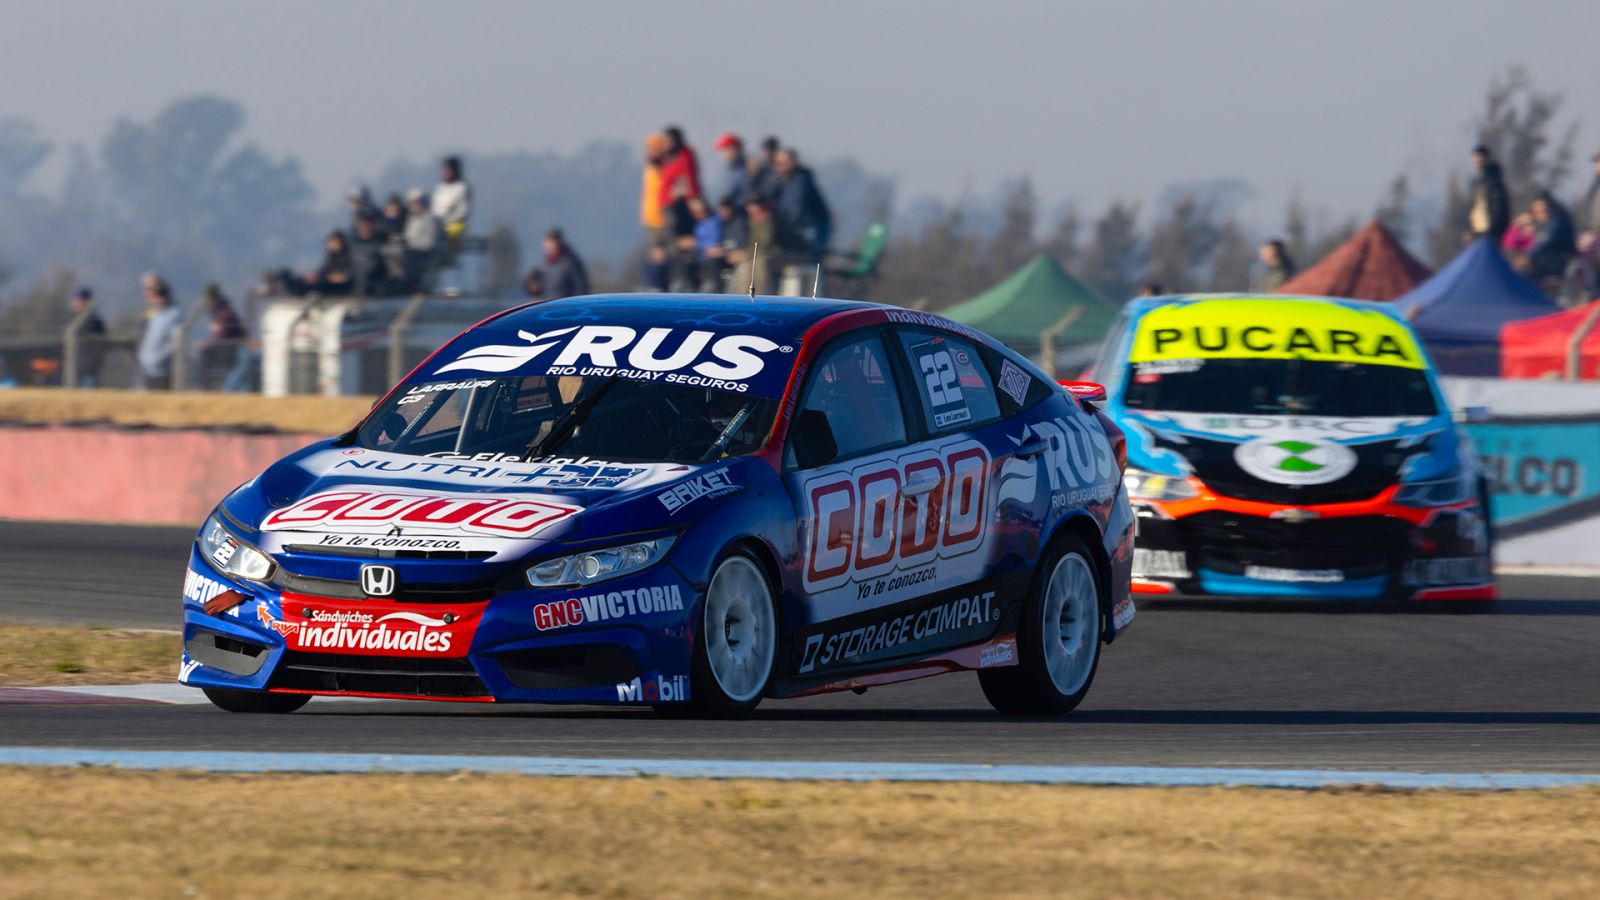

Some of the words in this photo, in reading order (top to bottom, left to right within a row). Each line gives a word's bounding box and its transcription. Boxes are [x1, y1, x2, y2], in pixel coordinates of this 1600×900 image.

[1152, 326, 1411, 360] PUCARA
[546, 367, 577, 376] RIO
[580, 367, 663, 381] URUGUAY
[665, 373, 749, 392] SEGUROS
[920, 351, 963, 407] 22
[1030, 412, 1112, 491] RUS
[657, 467, 732, 511] BRIKET
[264, 490, 582, 534] COTO
[806, 446, 989, 585] COTO
[319, 535, 341, 547] Yo
[349, 536, 368, 547] te
[857, 583, 870, 600] Yo
[873, 579, 886, 594] te
[311, 609, 373, 623] Sándwiches
[298, 621, 452, 651] individuales
[821, 613, 914, 664] STORAGE
[617, 675, 685, 702] Mobil
